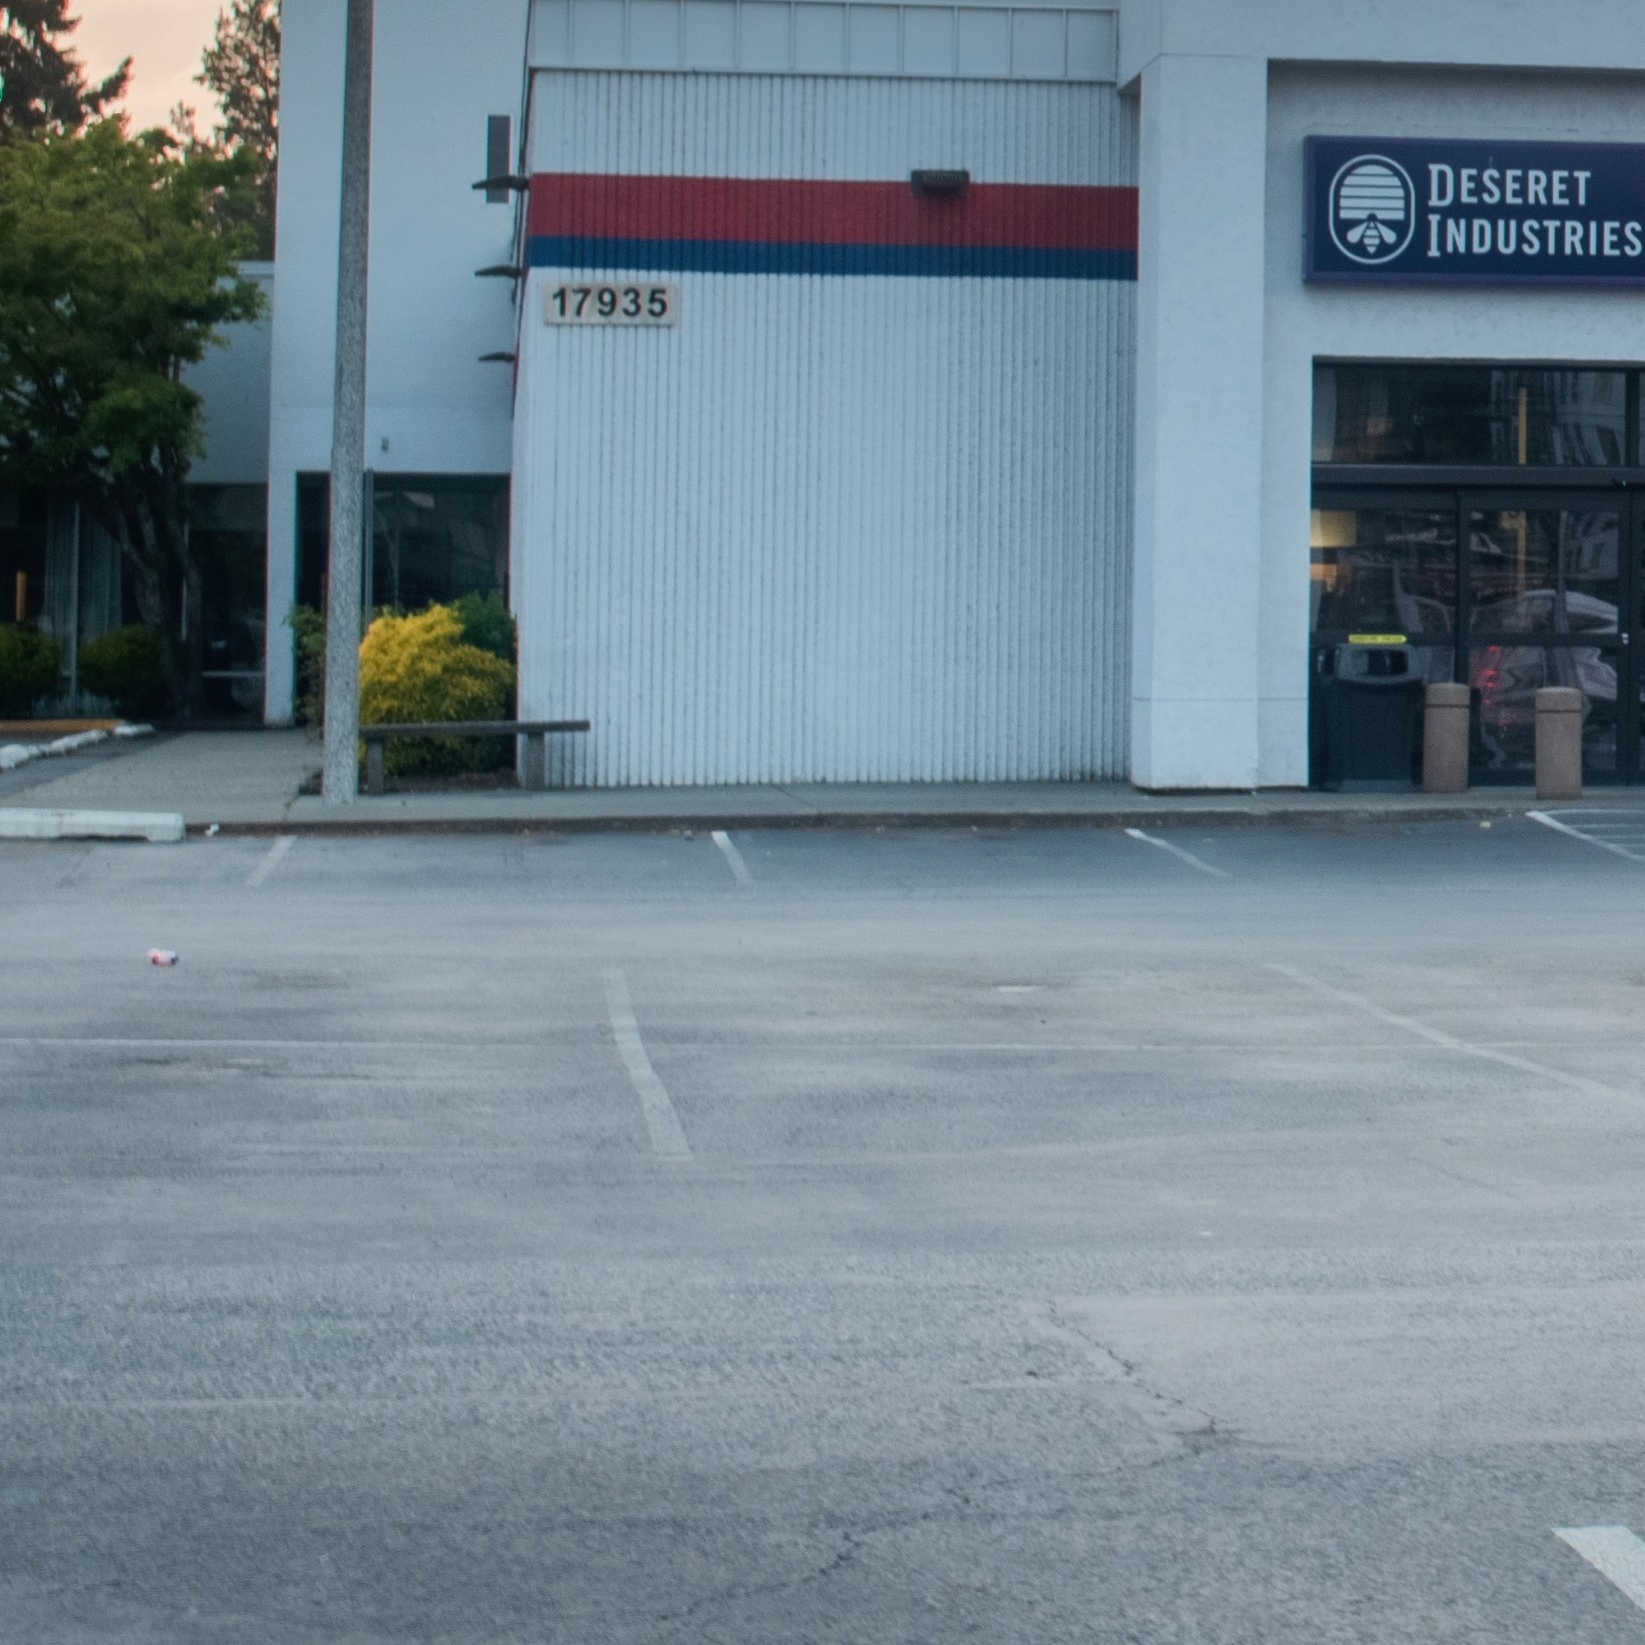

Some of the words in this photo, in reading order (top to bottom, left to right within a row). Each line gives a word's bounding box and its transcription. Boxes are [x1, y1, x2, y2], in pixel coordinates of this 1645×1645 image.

[1428, 163, 1592, 207] DESERET
[1427, 213, 1643, 257] INDUSTRIES
[552, 286, 668, 319] 17935
